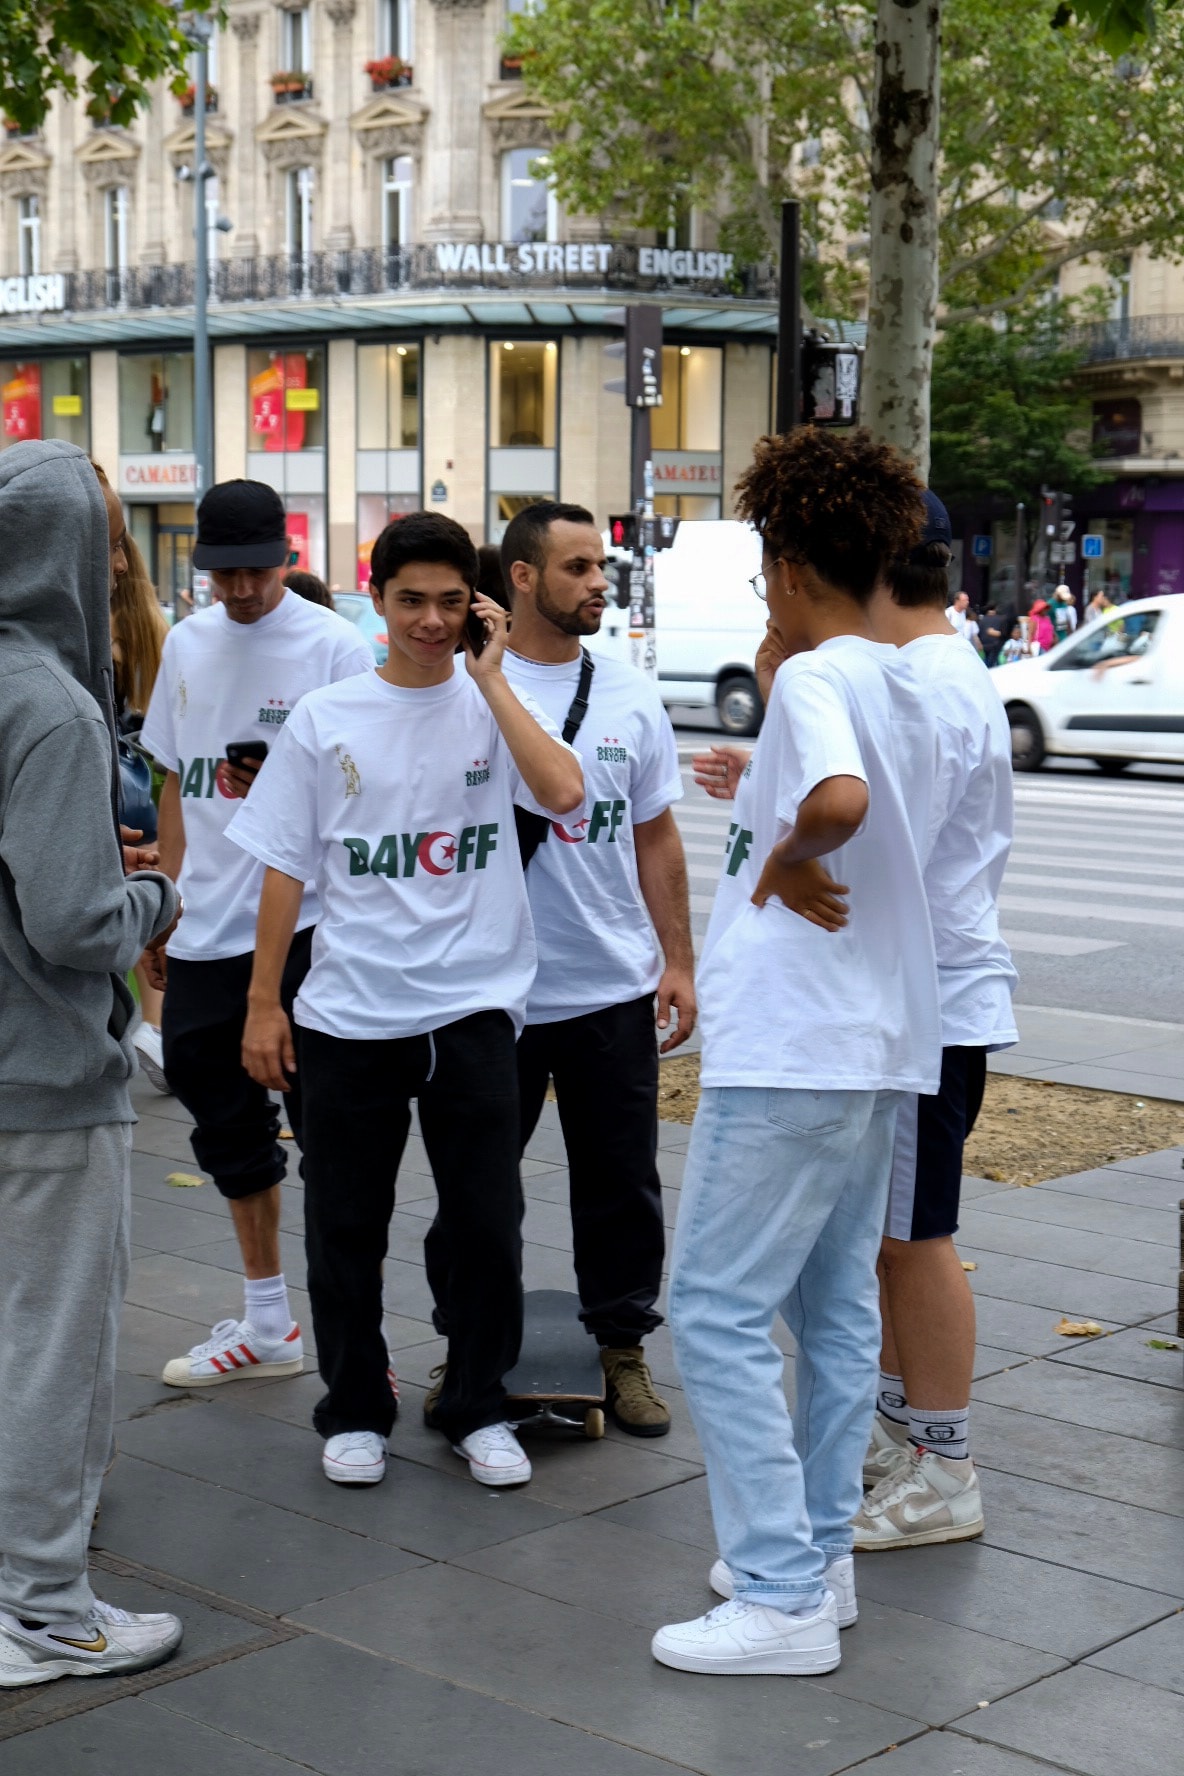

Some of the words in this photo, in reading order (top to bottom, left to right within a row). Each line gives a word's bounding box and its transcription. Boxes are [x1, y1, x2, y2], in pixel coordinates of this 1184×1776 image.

[436, 243, 509, 272] WALL
[517, 243, 612, 273] STREET
[638, 247, 735, 278] ENGLISH
